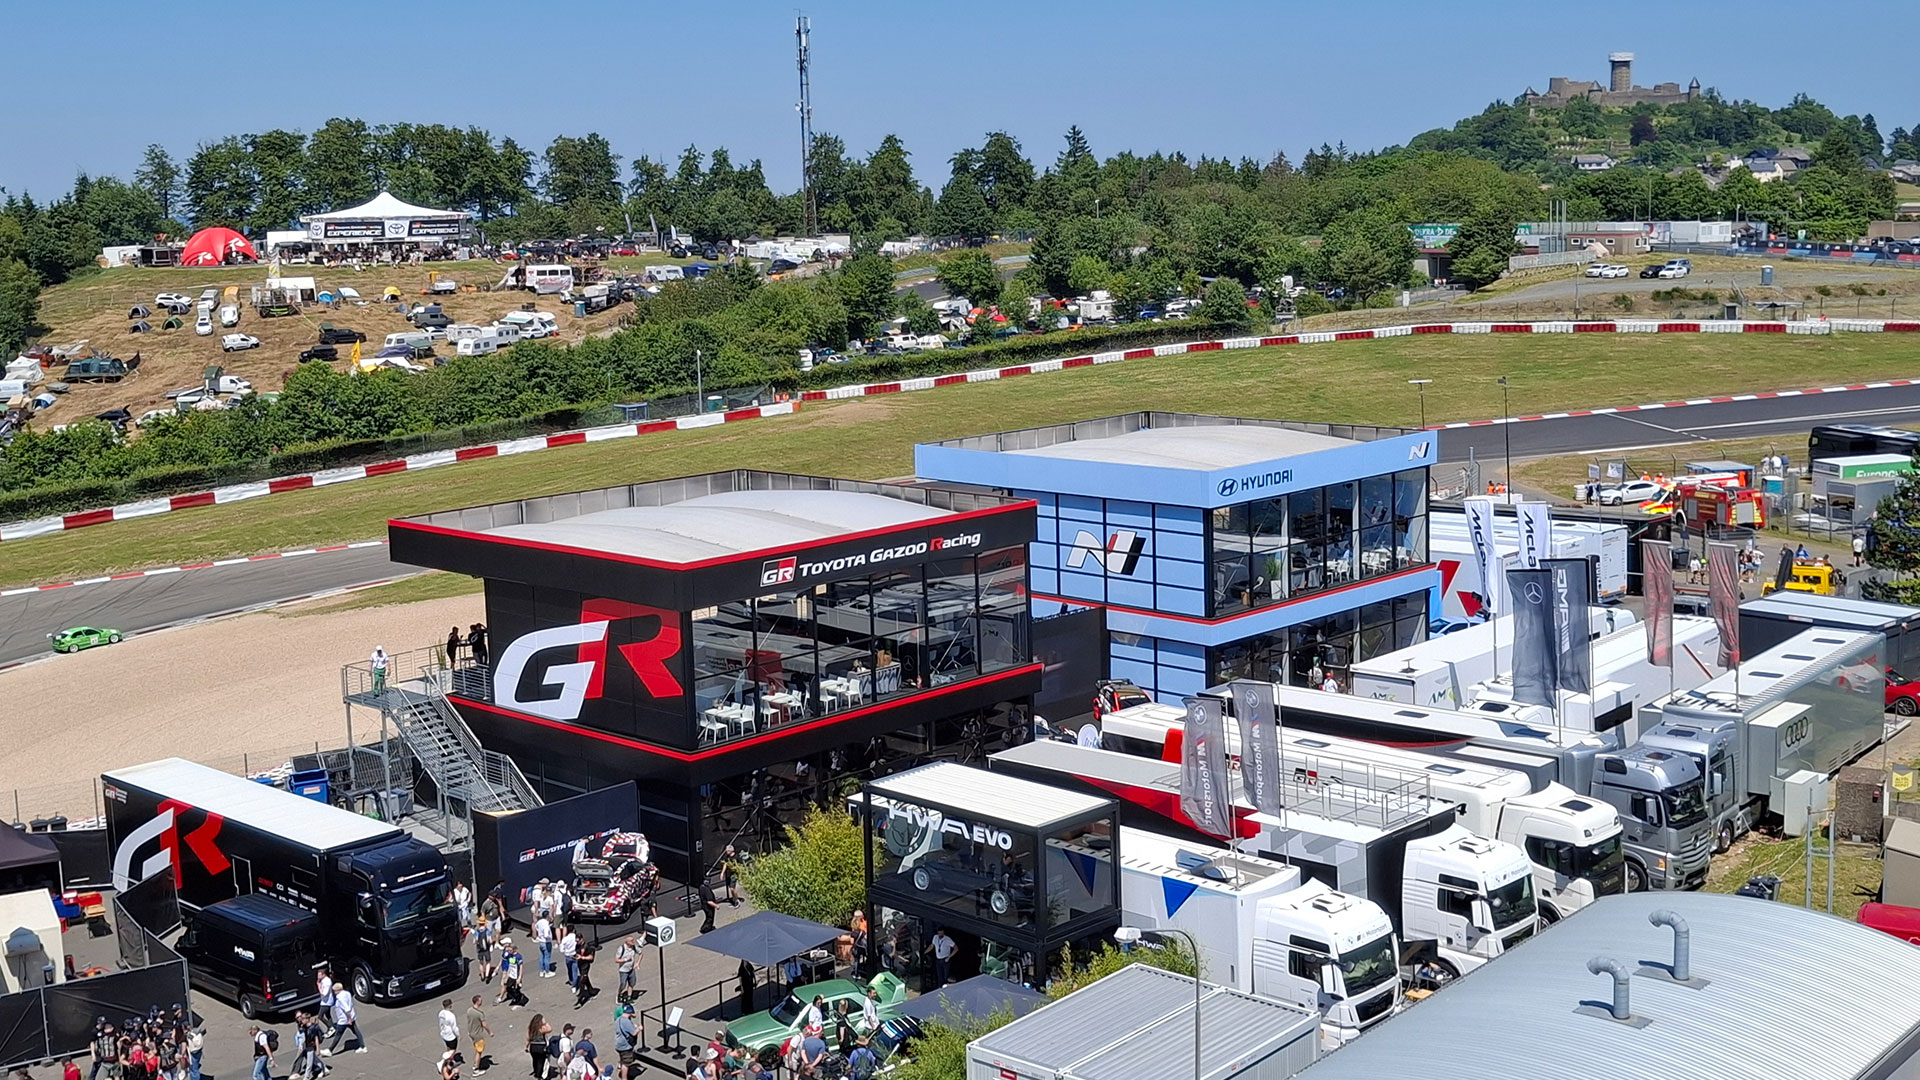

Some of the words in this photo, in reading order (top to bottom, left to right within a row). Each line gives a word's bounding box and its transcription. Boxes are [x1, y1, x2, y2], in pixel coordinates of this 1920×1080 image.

[1241, 469, 1293, 491] HYUNDAI
[762, 566, 793, 584] GR
[800, 554, 866, 577] TOYOTA
[930, 532, 981, 551] Racing
[494, 598, 683, 720] GR
[595, 827, 620, 839] Racing
[889, 804, 971, 840] HWA
[973, 825, 1013, 850] EVO
